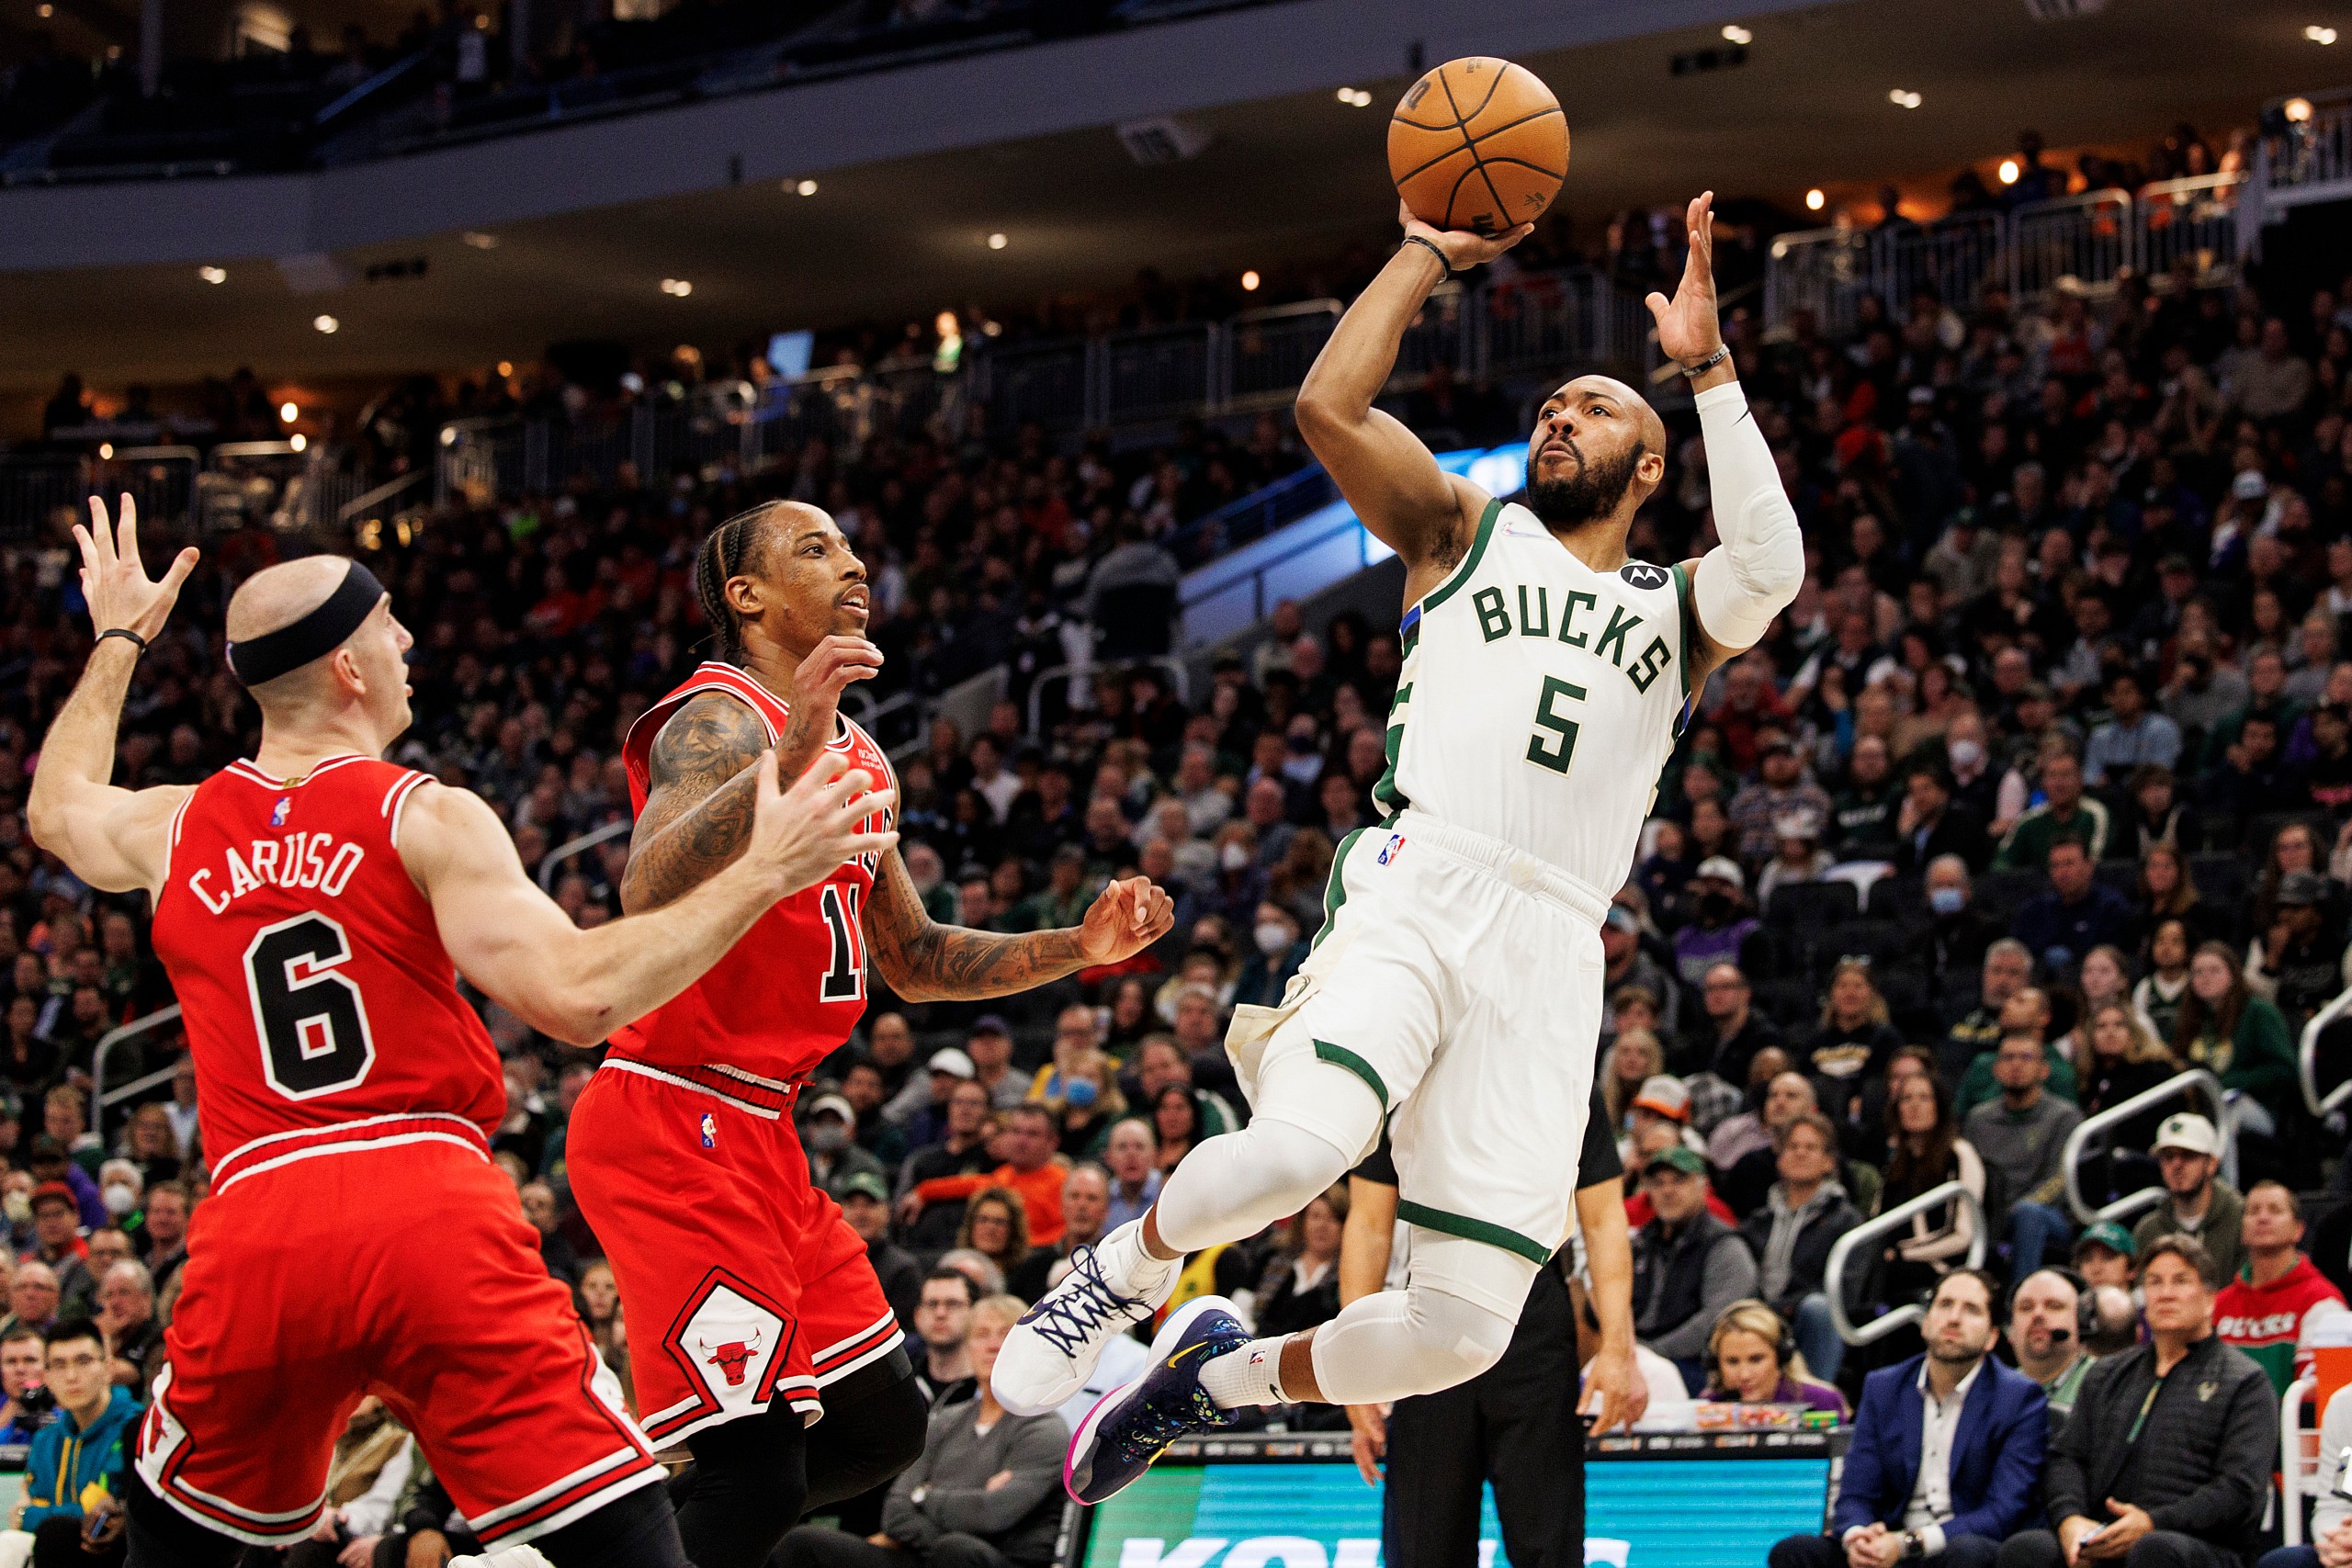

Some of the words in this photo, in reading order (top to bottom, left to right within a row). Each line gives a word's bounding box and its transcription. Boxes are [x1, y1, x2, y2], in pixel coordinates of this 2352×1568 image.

[1471, 584, 1673, 698] BUCKS
[1521, 672, 1589, 778] 5
[188, 830, 365, 916] CARUSO
[242, 908, 377, 1102] 6
